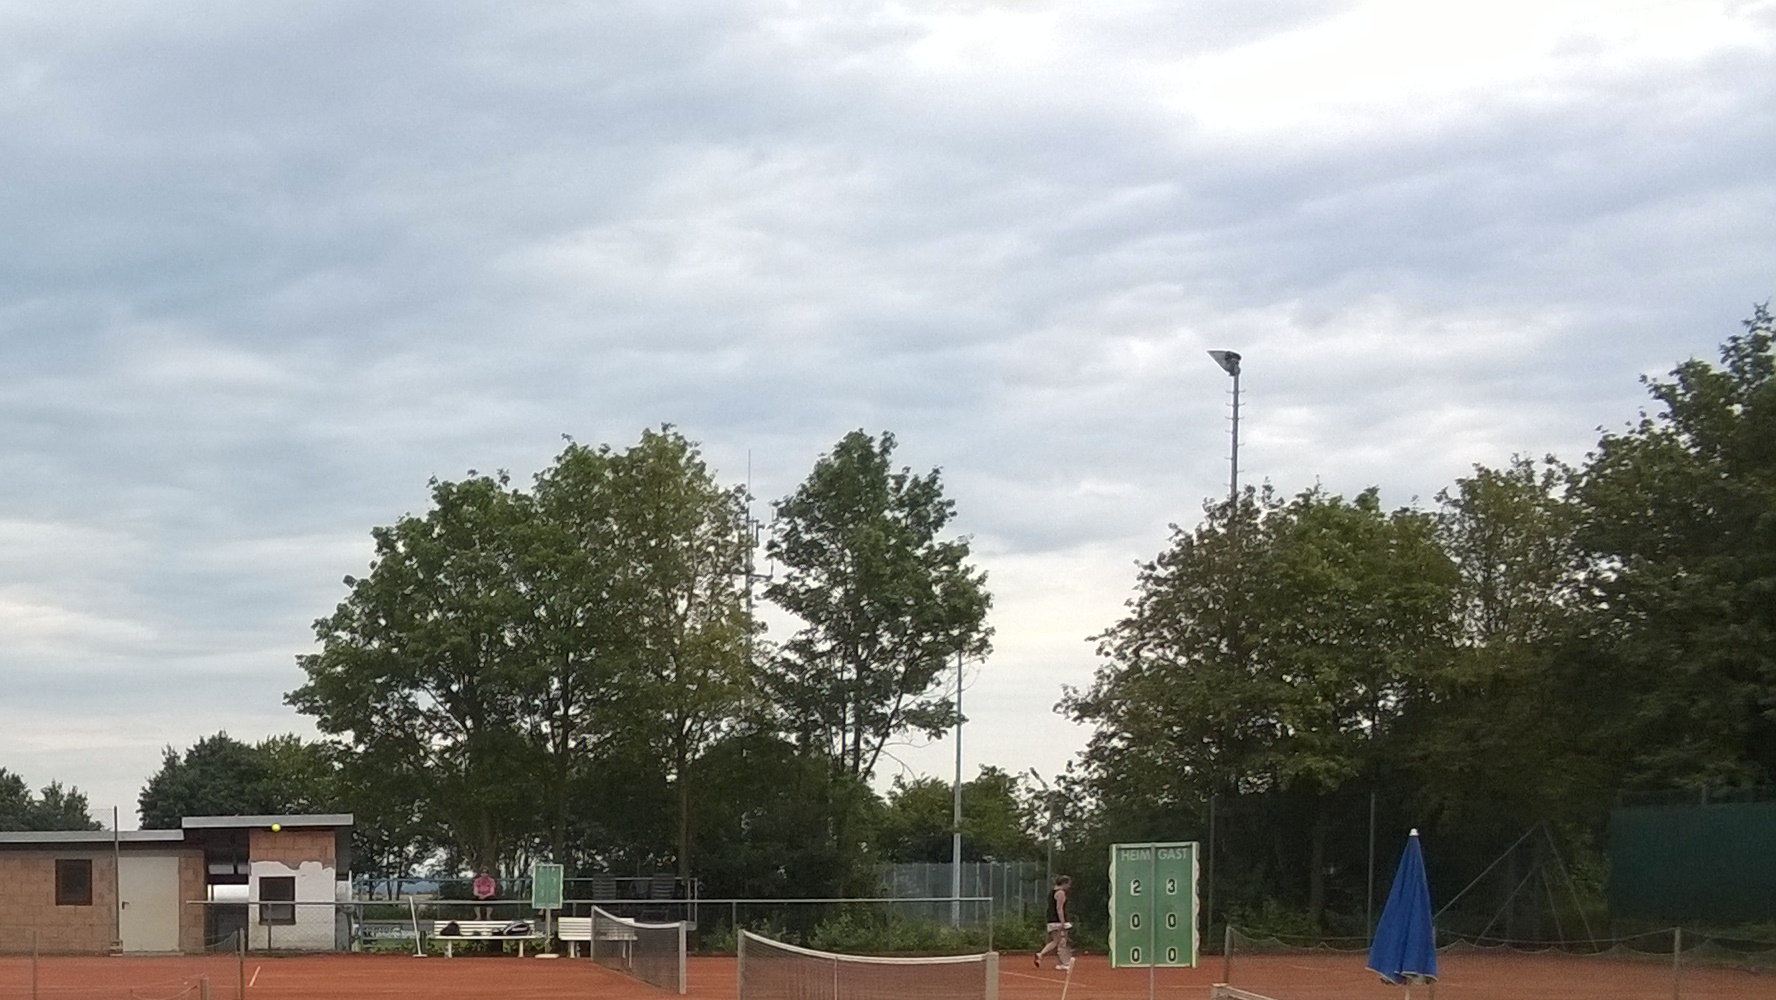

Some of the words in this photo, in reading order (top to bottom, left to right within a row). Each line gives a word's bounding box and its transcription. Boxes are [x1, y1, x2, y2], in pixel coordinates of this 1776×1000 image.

[1120, 849, 1152, 861] HEIM
[1157, 847, 1189, 860] GAST
[1132, 879, 1142, 894] 2
[1167, 878, 1176, 893] 3
[1132, 913, 1141, 928] 0
[1167, 913, 1177, 928] 0
[1132, 947, 1141, 962] 0
[1167, 947, 1177, 962] 0
